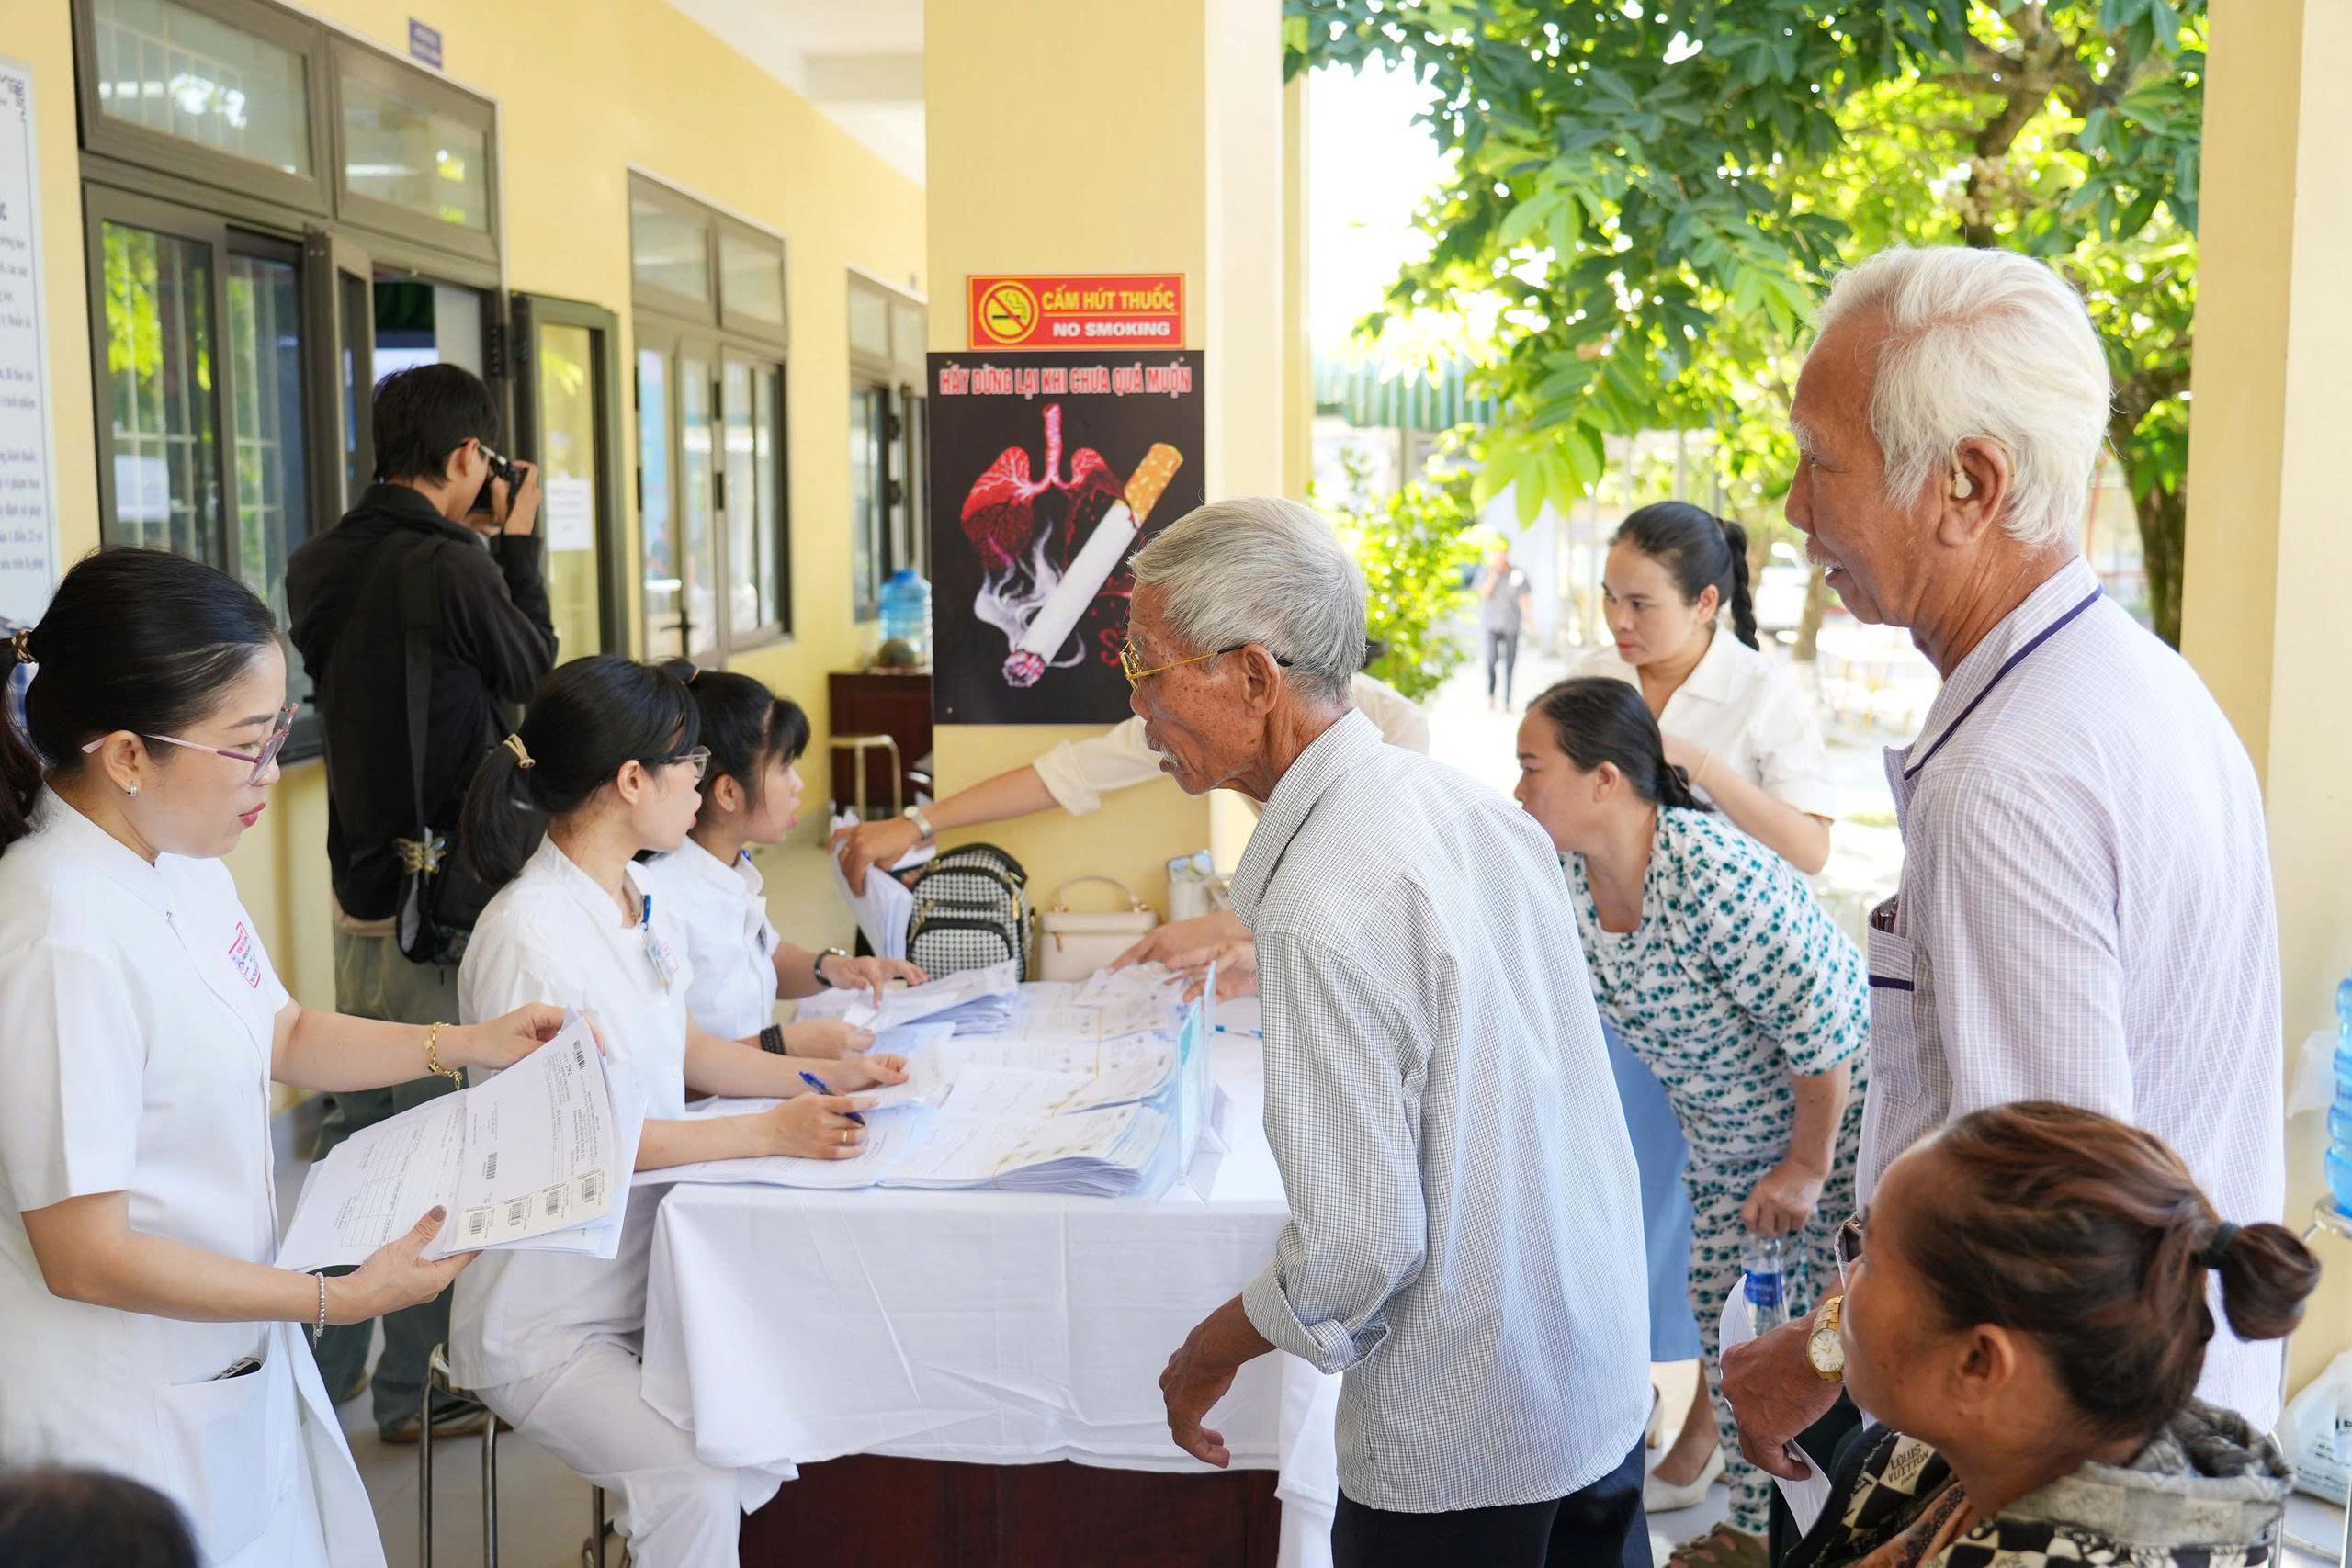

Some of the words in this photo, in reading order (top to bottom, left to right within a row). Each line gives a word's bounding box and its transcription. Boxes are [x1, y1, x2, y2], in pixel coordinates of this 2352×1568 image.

[1042, 284, 1080, 310] CẤM
[1083, 284, 1117, 310] HÚT
[1120, 283, 1175, 310] THUỐC
[1053, 322, 1080, 337] NO
[1084, 321, 1170, 337] SMOKING
[939, 364, 970, 395] HÃY
[971, 363, 1013, 395] DỪNG
[1014, 367, 1040, 400] LẠI
[1041, 367, 1068, 394] KHI
[1069, 364, 1111, 394] CHƯA
[1112, 361, 1144, 396] QUÁ
[1145, 361, 1192, 399] MUỘN
[1888, 1449, 1929, 1483] VUITTON
[1890, 1443, 1922, 1470] LOUIS
